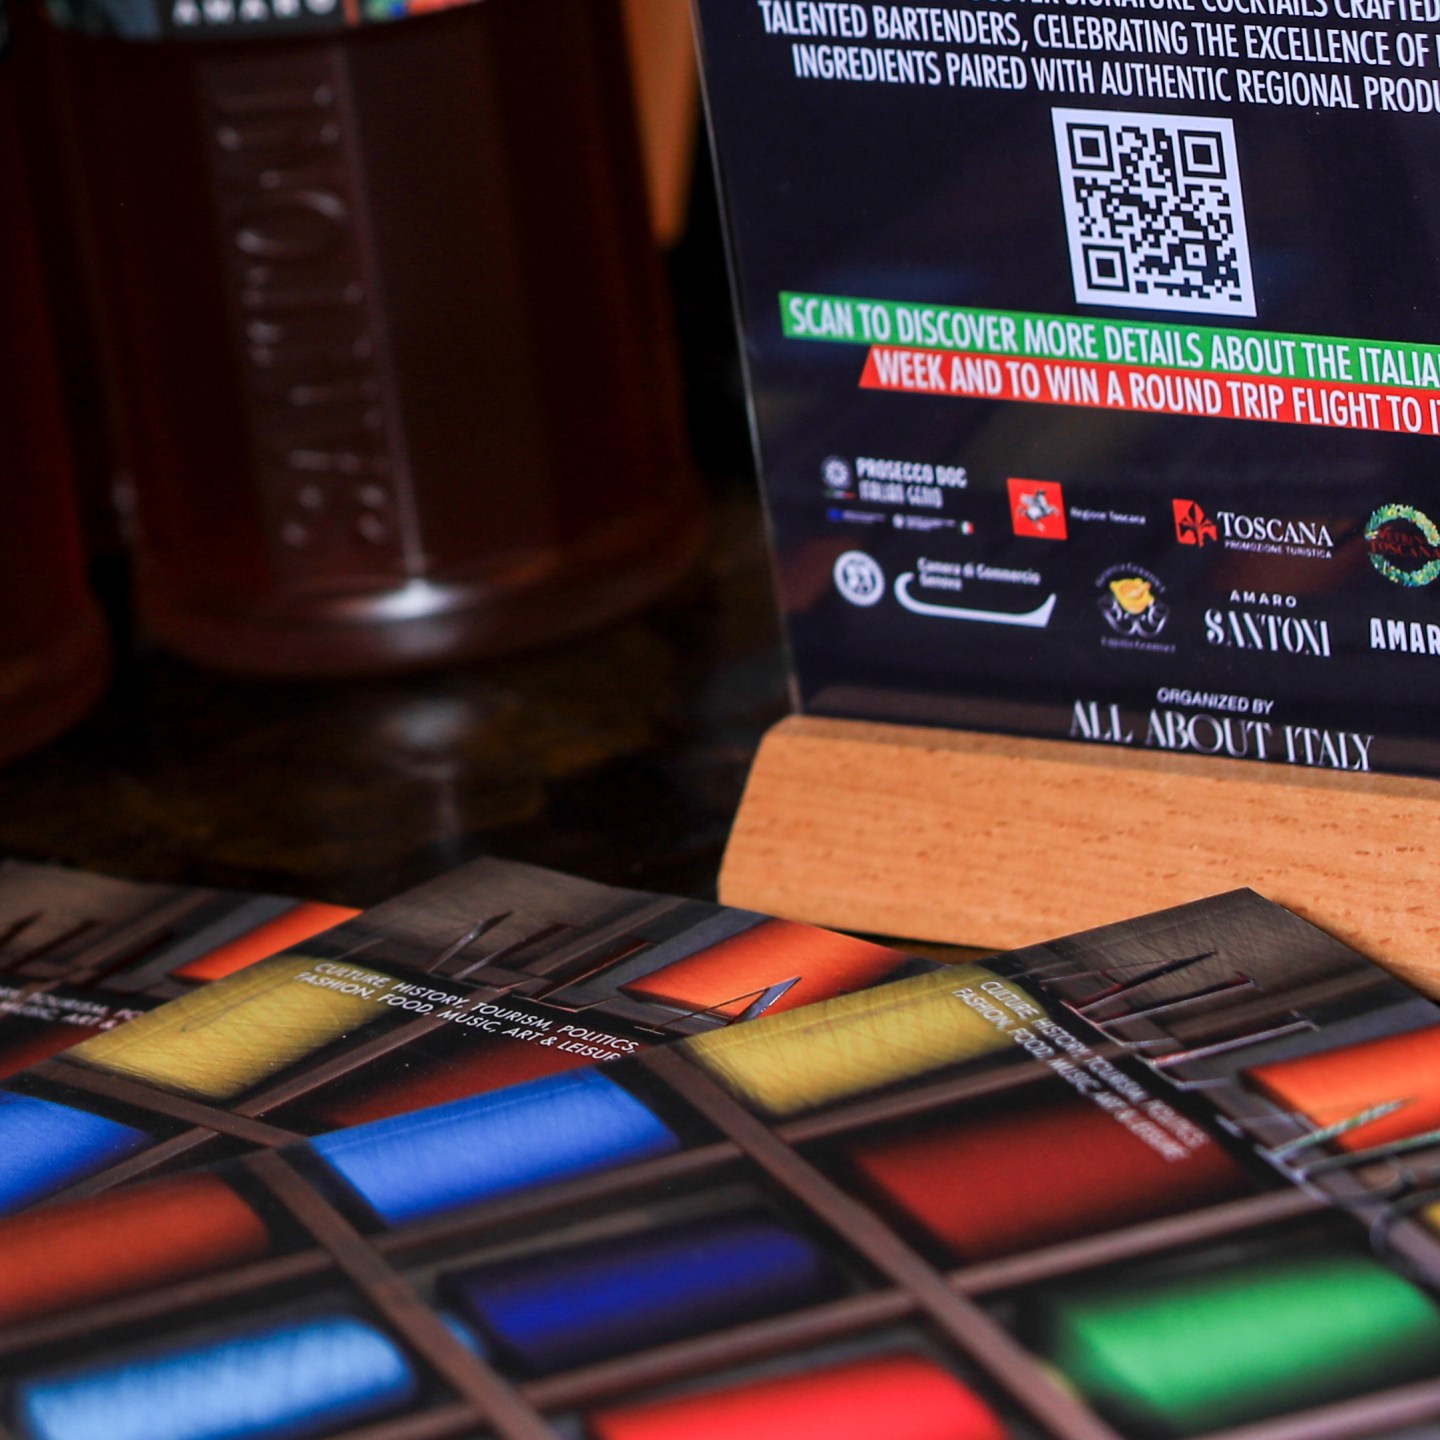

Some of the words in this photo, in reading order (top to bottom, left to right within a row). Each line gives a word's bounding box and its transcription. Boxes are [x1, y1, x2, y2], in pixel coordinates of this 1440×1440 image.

[758, 0, 868, 38] TALENTED
[873, 5, 1029, 52] BARTENDERS,
[1033, 13, 1188, 56] CELEBRATING
[1191, 22, 1240, 58] THE
[1244, 25, 1392, 66] EXCELLENCE
[1396, 32, 1430, 68] OF
[791, 43, 941, 85] INGREDIENTS
[945, 52, 1028, 90] PAIRED
[1031, 57, 1095, 94] WITH
[1100, 62, 1232, 103] AUTHENTIC
[1236, 68, 1359, 109] REGIONAL
[789, 297, 855, 338] SCAN
[856, 303, 891, 341] TO
[895, 307, 1019, 353] DISCOVER
[1023, 318, 1099, 359] MORE
[1104, 324, 1204, 369] DETAILS
[1210, 334, 1296, 376] ABOUT
[1301, 342, 1353, 380] THE
[1359, 347, 1440, 389] ITALIA
[873, 348, 945, 391] WEEK
[950, 356, 1002, 395] AND
[1005, 361, 1040, 398] TO
[1044, 364, 1100, 404] WIN
[1107, 370, 1125, 407] A
[1128, 372, 1222, 415] ROUND
[1226, 381, 1284, 420] TRIP
[1292, 387, 1380, 429] FLIGHT
[1386, 394, 1422, 433] TO
[1430, 398, 1440, 434] I
[1217, 511, 1334, 547] TOSCANA
[1225, 540, 1282, 554] PROMOZIONE
[1286, 546, 1332, 559] TURISTICA
[1204, 608, 1330, 657] SANTONI
[1230, 590, 1297, 608] AMARO
[1157, 687, 1249, 712] ORGANIZED
[1252, 698, 1274, 714] BY
[1070, 700, 1133, 743] ALL
[1145, 709, 1273, 759] ABOUT
[1283, 724, 1374, 771] ITALY
[294, 972, 375, 1000] FASHION,
[377, 993, 433, 1016] FOOD,
[437, 1009, 501, 1033] MUSIC,
[502, 1026, 544, 1042] ART
[540, 1036, 558, 1047] &
[392, 982, 470, 1008] HISTORY,
[471, 1002, 554, 1031] TOURISM,
[557, 1025, 639, 1054] POLITICS,
